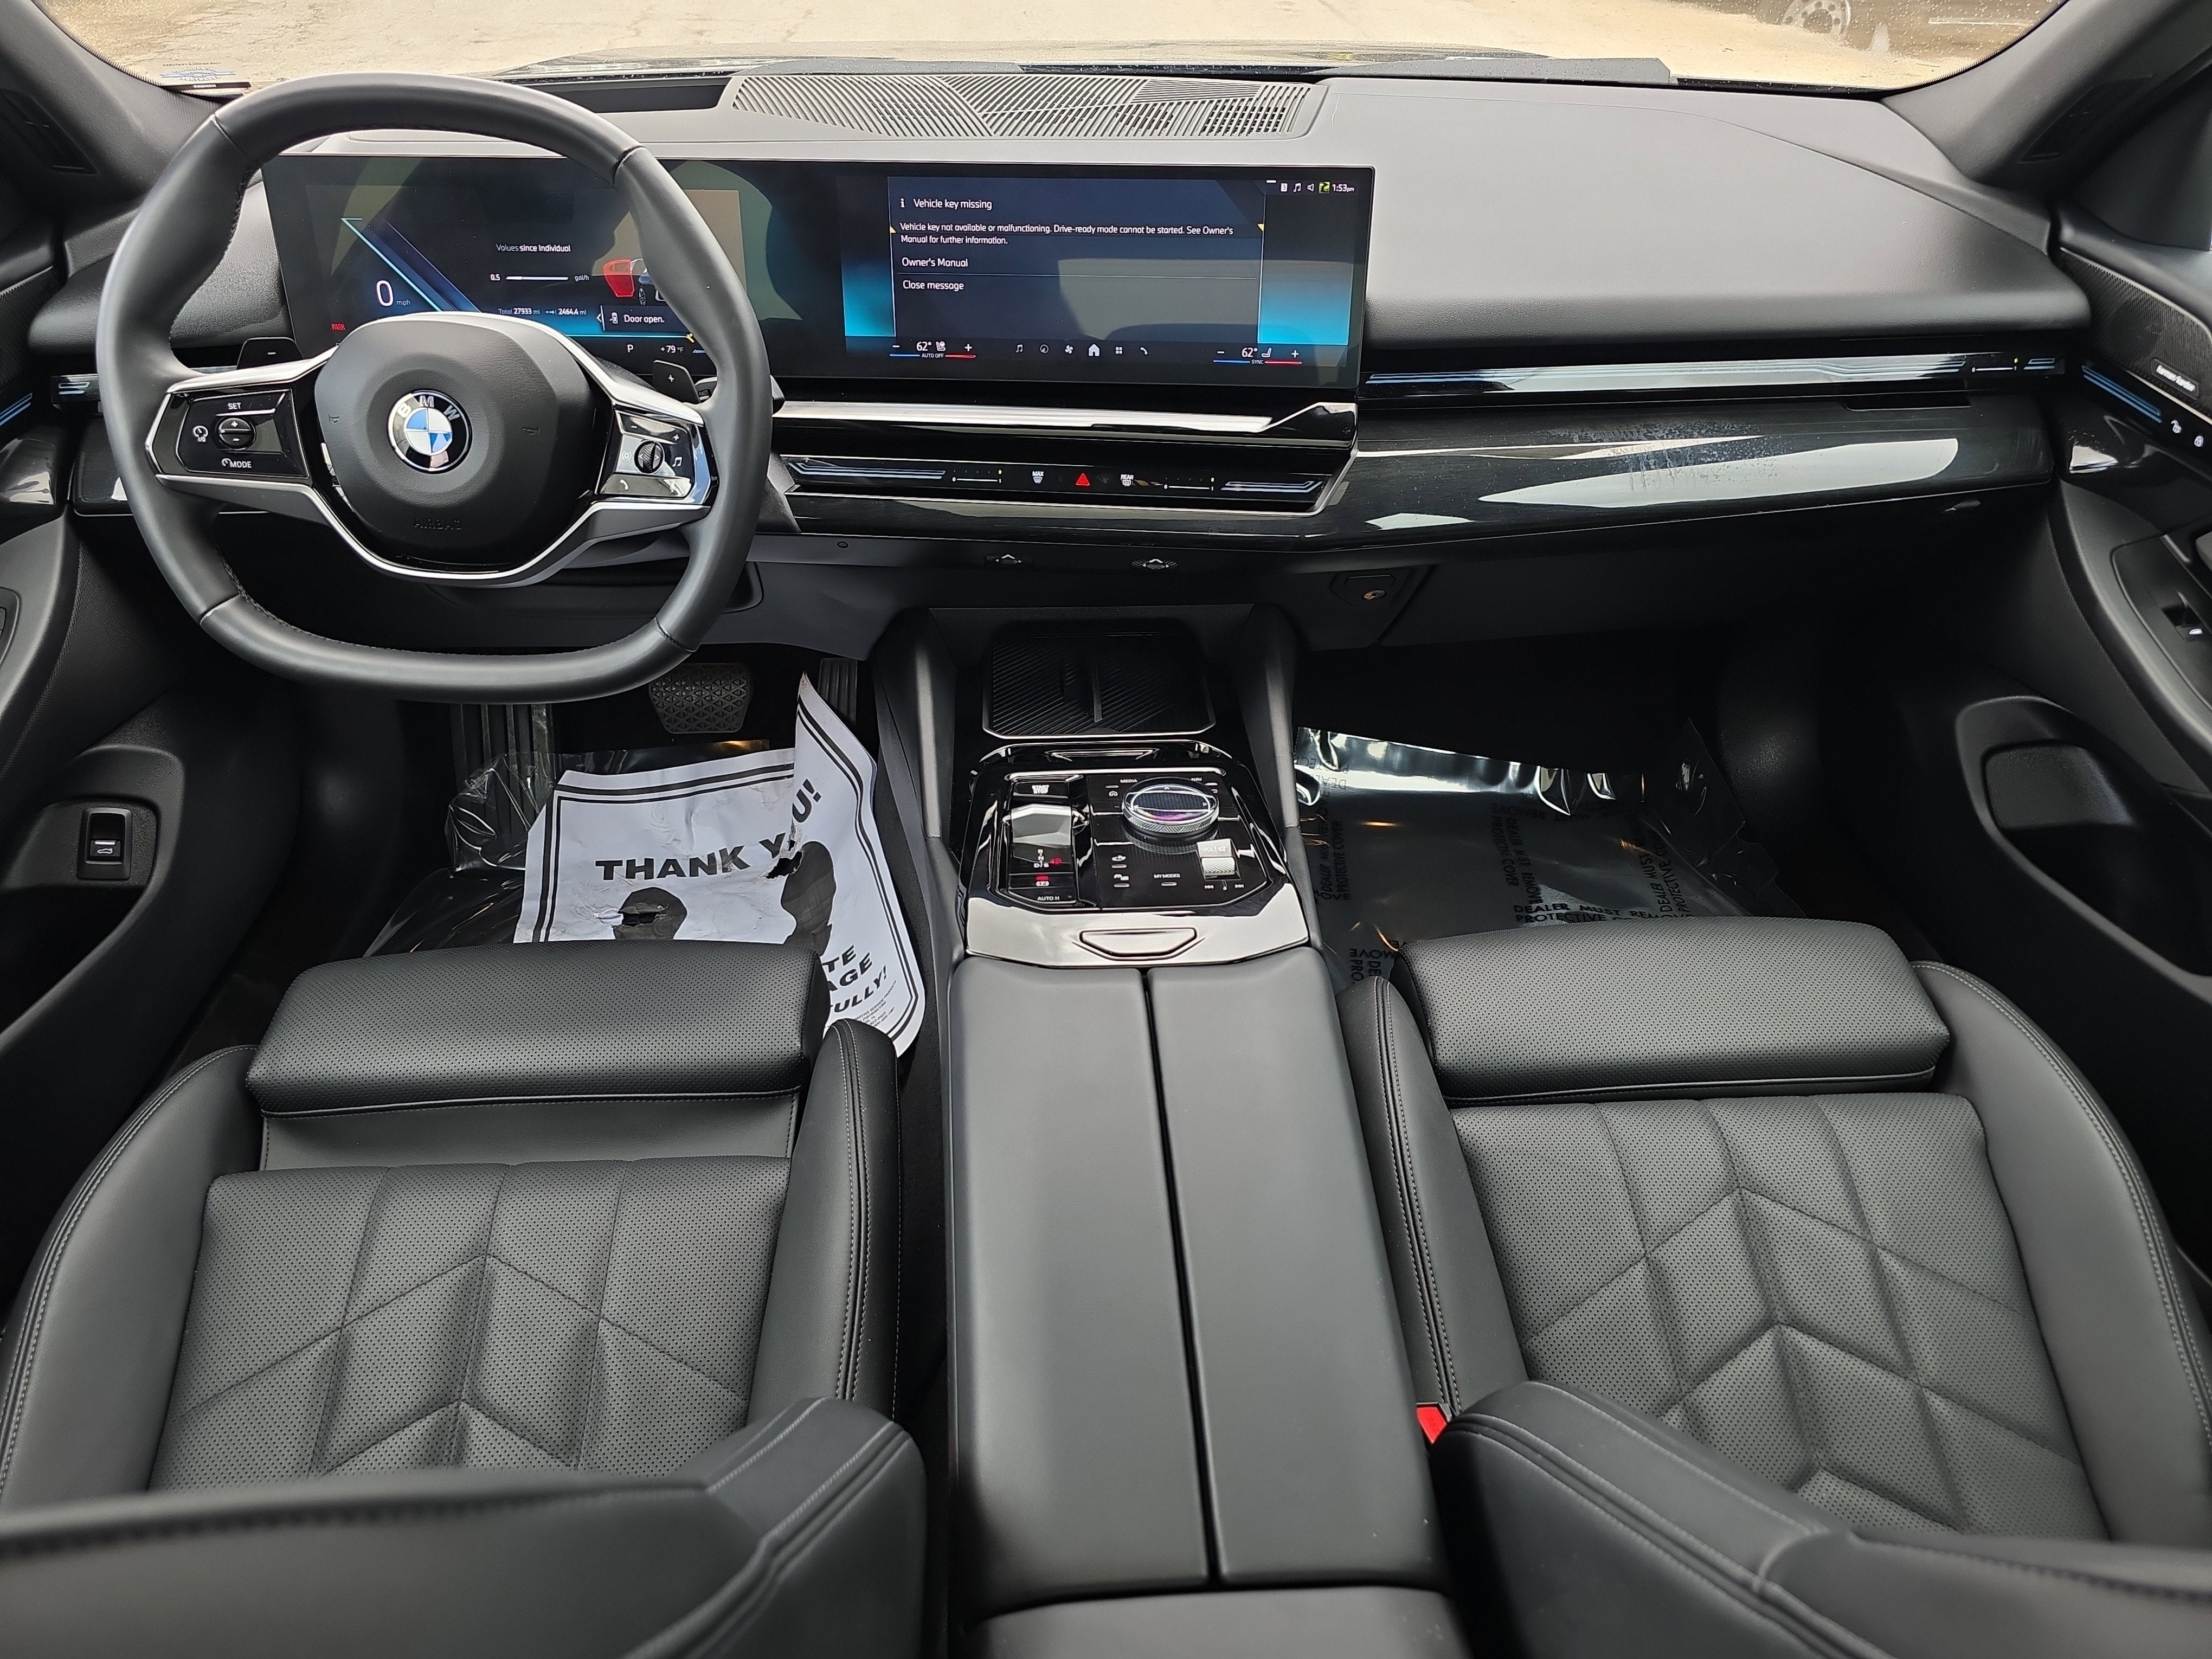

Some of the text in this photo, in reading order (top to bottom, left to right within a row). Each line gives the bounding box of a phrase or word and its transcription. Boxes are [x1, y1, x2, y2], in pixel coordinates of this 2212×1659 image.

[1332, 184, 1355, 192] 1:53pm
[913, 198, 943, 208] Vehicle
[944, 199, 959, 210] key
[960, 200, 992, 211] missing
[900, 223, 926, 231] Vehicle
[928, 223, 941, 233] key
[954, 223, 987, 232] available
[997, 224, 1052, 234] malfunctioning.
[1053, 224, 1096, 234] Drive-ready
[1097, 226, 1118, 234] mode
[1146, 226, 1156, 234] be
[1157, 226, 1185, 234] started.
[1186, 226, 1201, 234] See
[1203, 226, 1233, 235] Owner's
[901, 235, 928, 243] Manual
[929, 235, 939, 243] for
[965, 236, 1008, 245] information.
[902, 257, 968, 267] Owner's Manual
[903, 280, 964, 291] Close message
[376, 280, 394, 306] 0
[623, 314, 665, 324] Door open.
[627, 344, 634, 353] P
[397, 395, 460, 421] BMW
[595, 778, 822, 881] THANK YU!
[1502, 859, 1520, 886] COVER
[1639, 853, 1659, 879] MUST
[1659, 859, 1690, 912] PROTECTIVE
[1650, 883, 1673, 912] DEALER
[1514, 903, 1571, 913] DEALER
[1580, 904, 1622, 916] MUST
[1516, 912, 1607, 922] PROTECTIVE
[831, 964, 887, 1013] ULLY!
